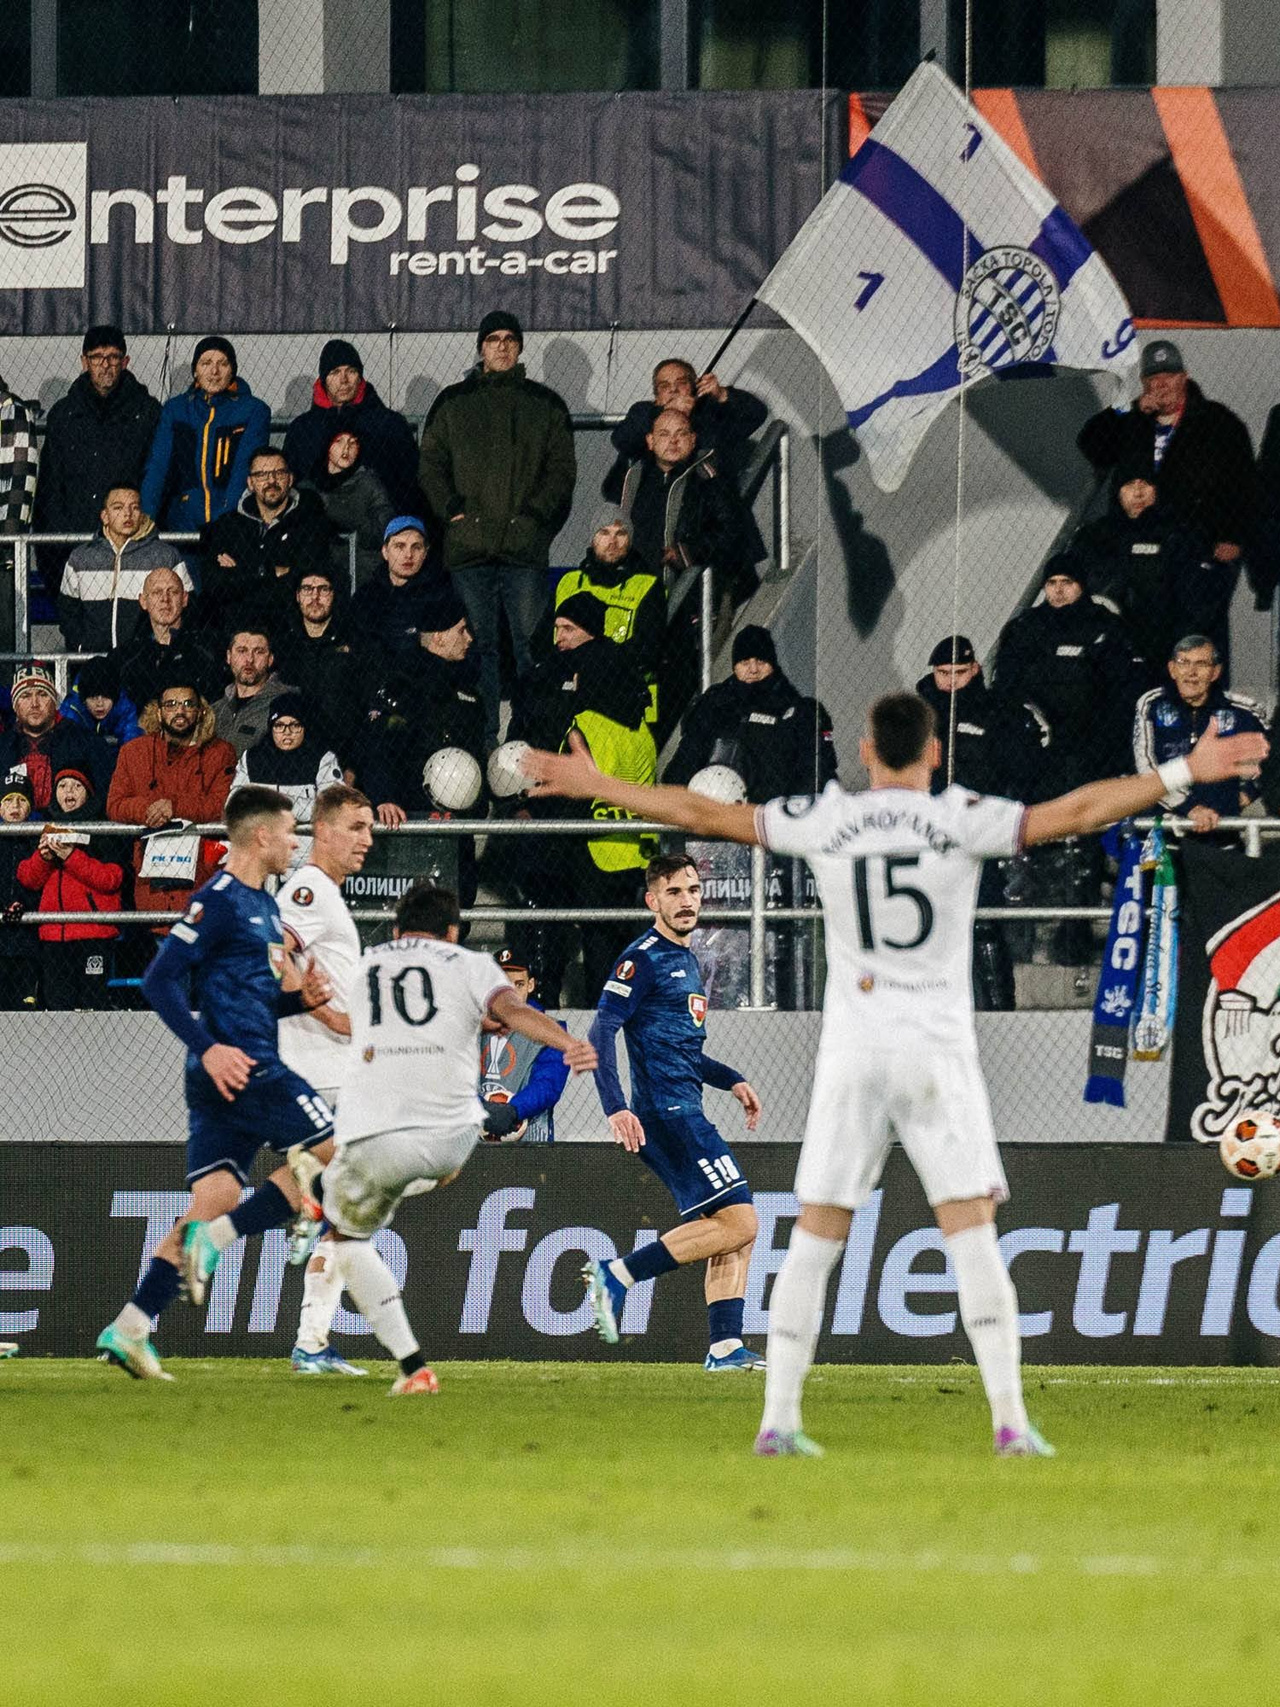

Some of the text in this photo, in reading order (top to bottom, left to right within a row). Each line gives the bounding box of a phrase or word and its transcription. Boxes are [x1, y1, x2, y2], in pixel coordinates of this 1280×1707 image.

[0, 162, 622, 266] enterprise
[388, 246, 619, 276] rent-a-car
[987, 285, 1029, 346] TSC
[345, 876, 437, 900] ПОЛИЦИ
[852, 852, 935, 952] 15
[367, 964, 439, 1027] 10
[1095, 1044, 1125, 1059] TSC
